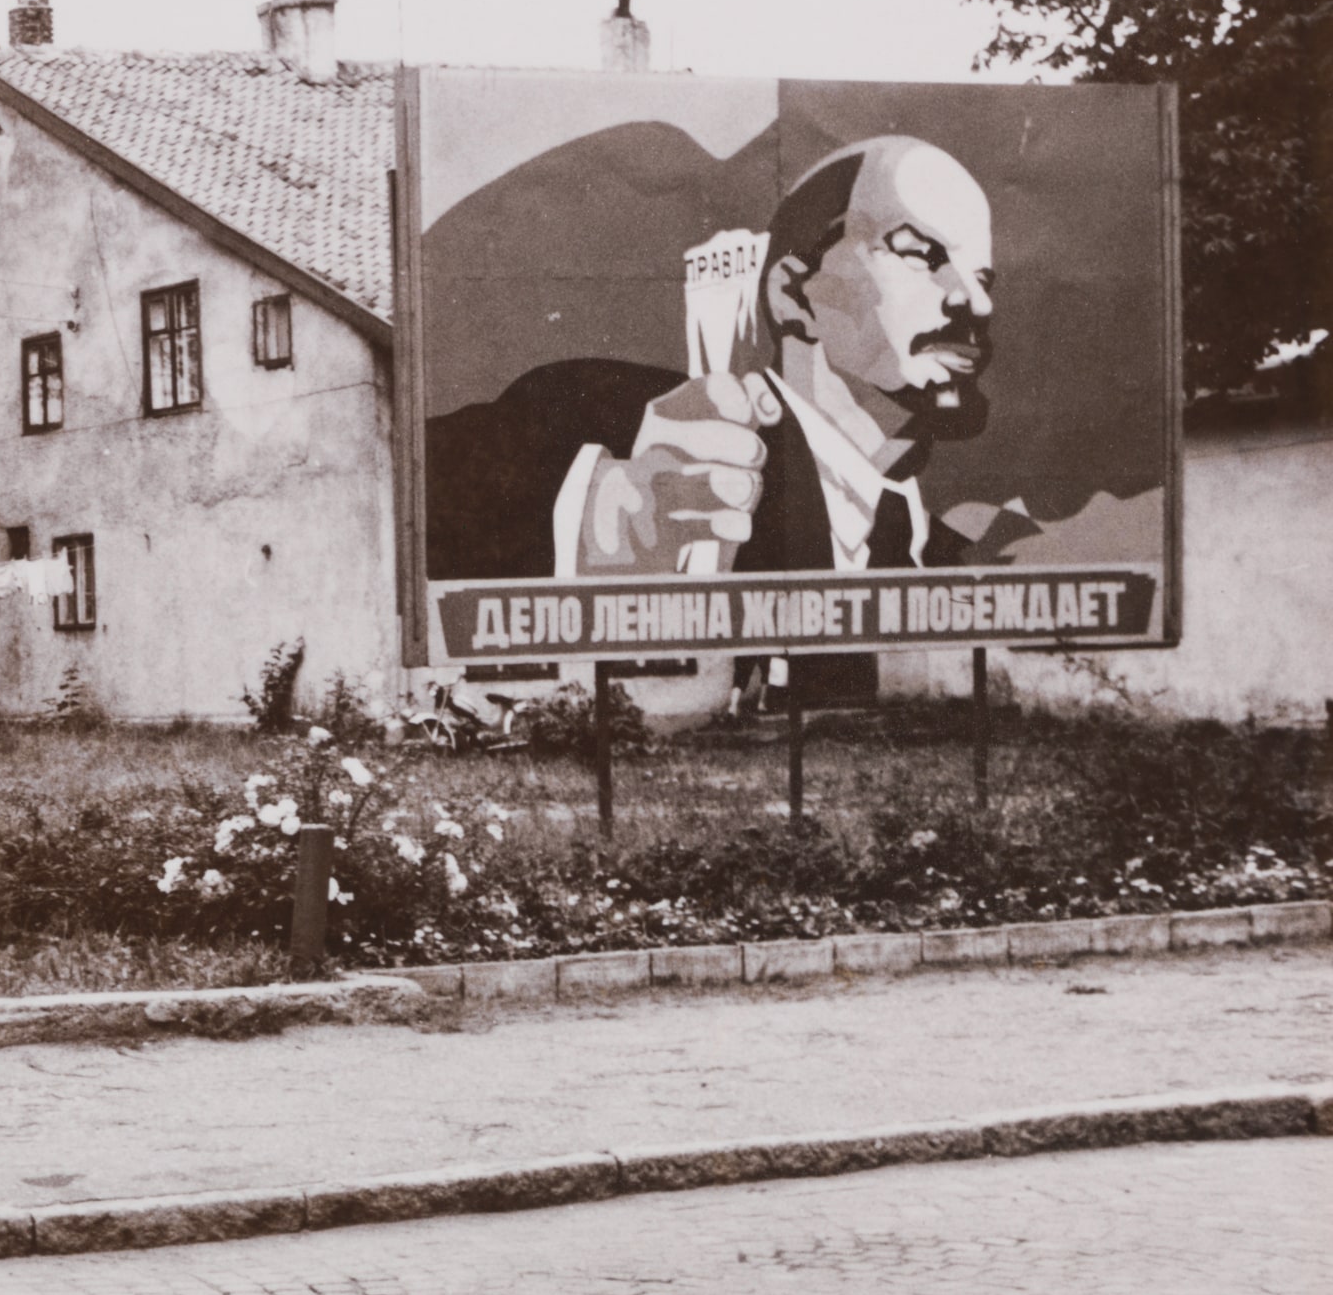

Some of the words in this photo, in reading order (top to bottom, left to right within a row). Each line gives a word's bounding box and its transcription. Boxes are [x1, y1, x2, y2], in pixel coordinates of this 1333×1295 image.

[685, 243, 757, 282] ПРАВДА
[472, 596, 582, 649] ДЕЛО
[590, 592, 732, 642] ЛЕНИНА
[741, 588, 871, 638] ЖИВЕТ
[879, 587, 901, 633] И
[907, 582, 1126, 632] ПОБЕЖДАЕТ
